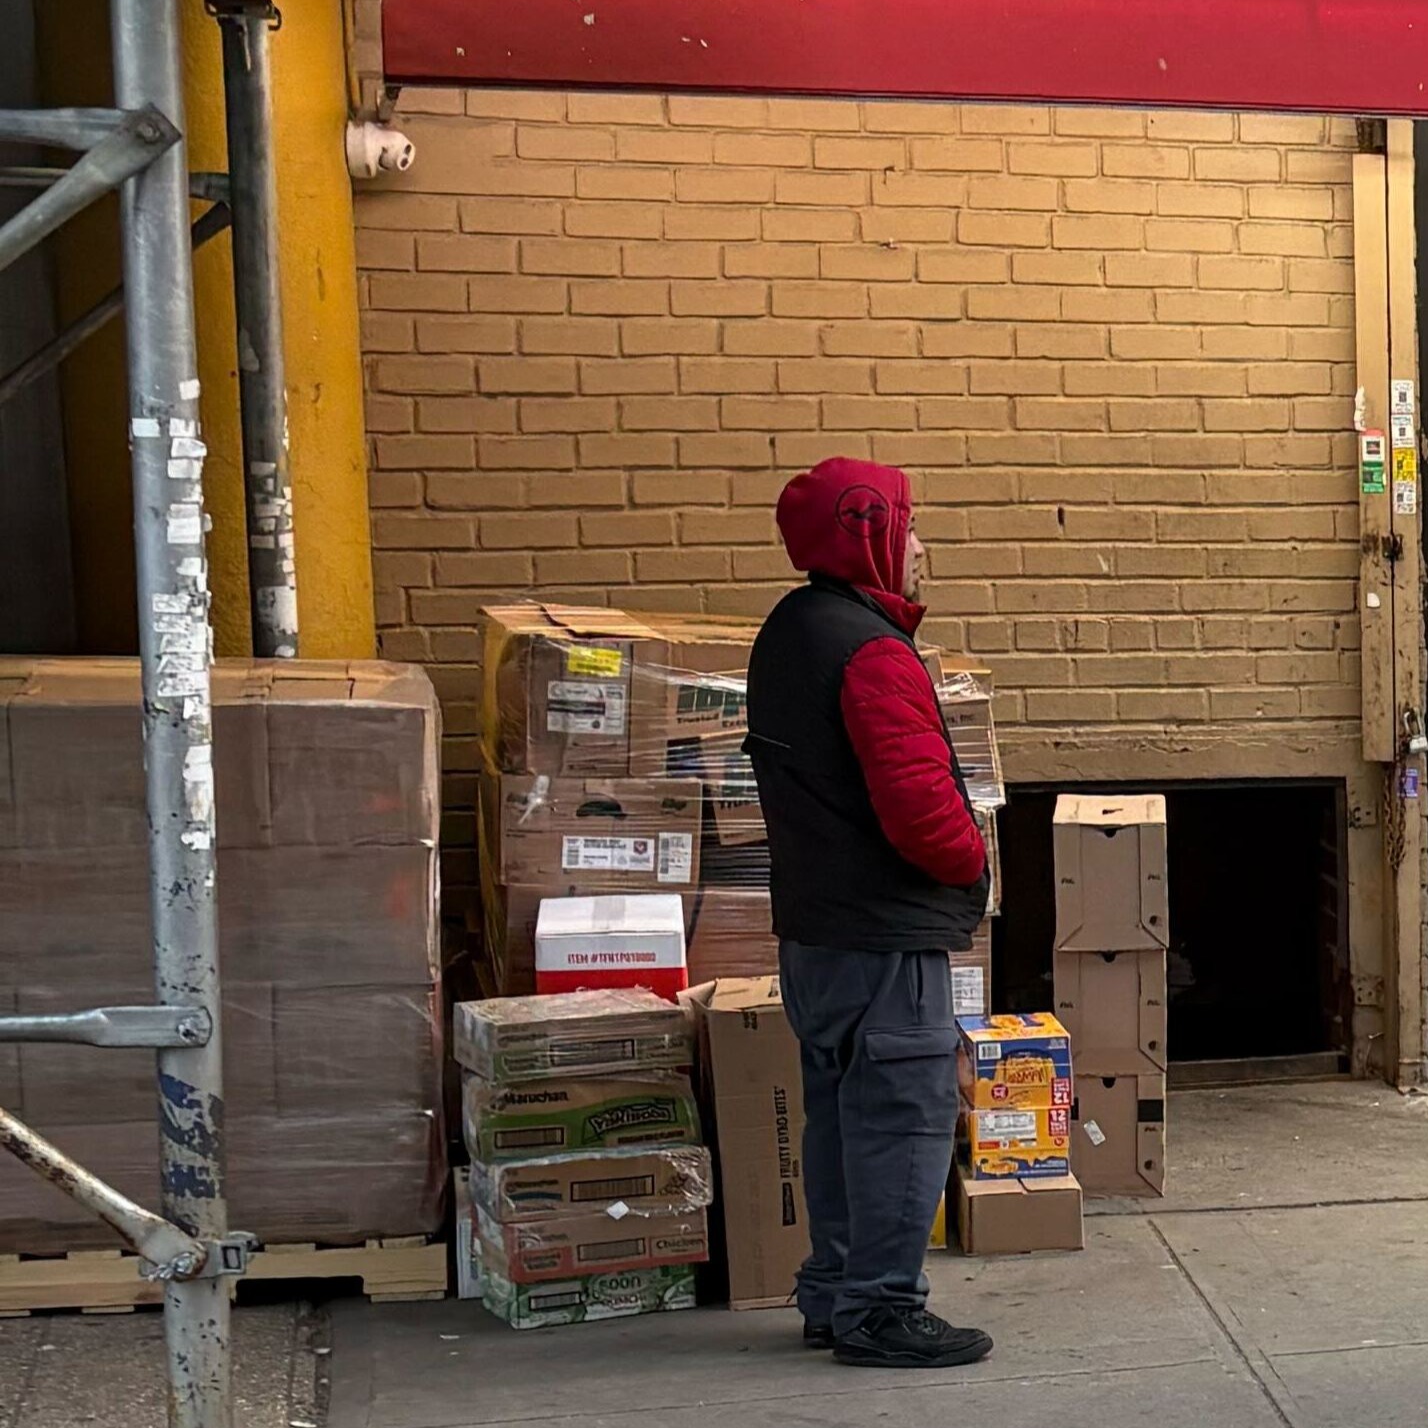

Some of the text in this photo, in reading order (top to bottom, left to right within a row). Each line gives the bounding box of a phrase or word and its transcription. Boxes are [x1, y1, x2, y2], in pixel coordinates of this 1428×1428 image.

[566, 953, 589, 965] ITEM
[504, 1090, 569, 1104] Maruchan
[656, 1238, 705, 1250] Chicken
